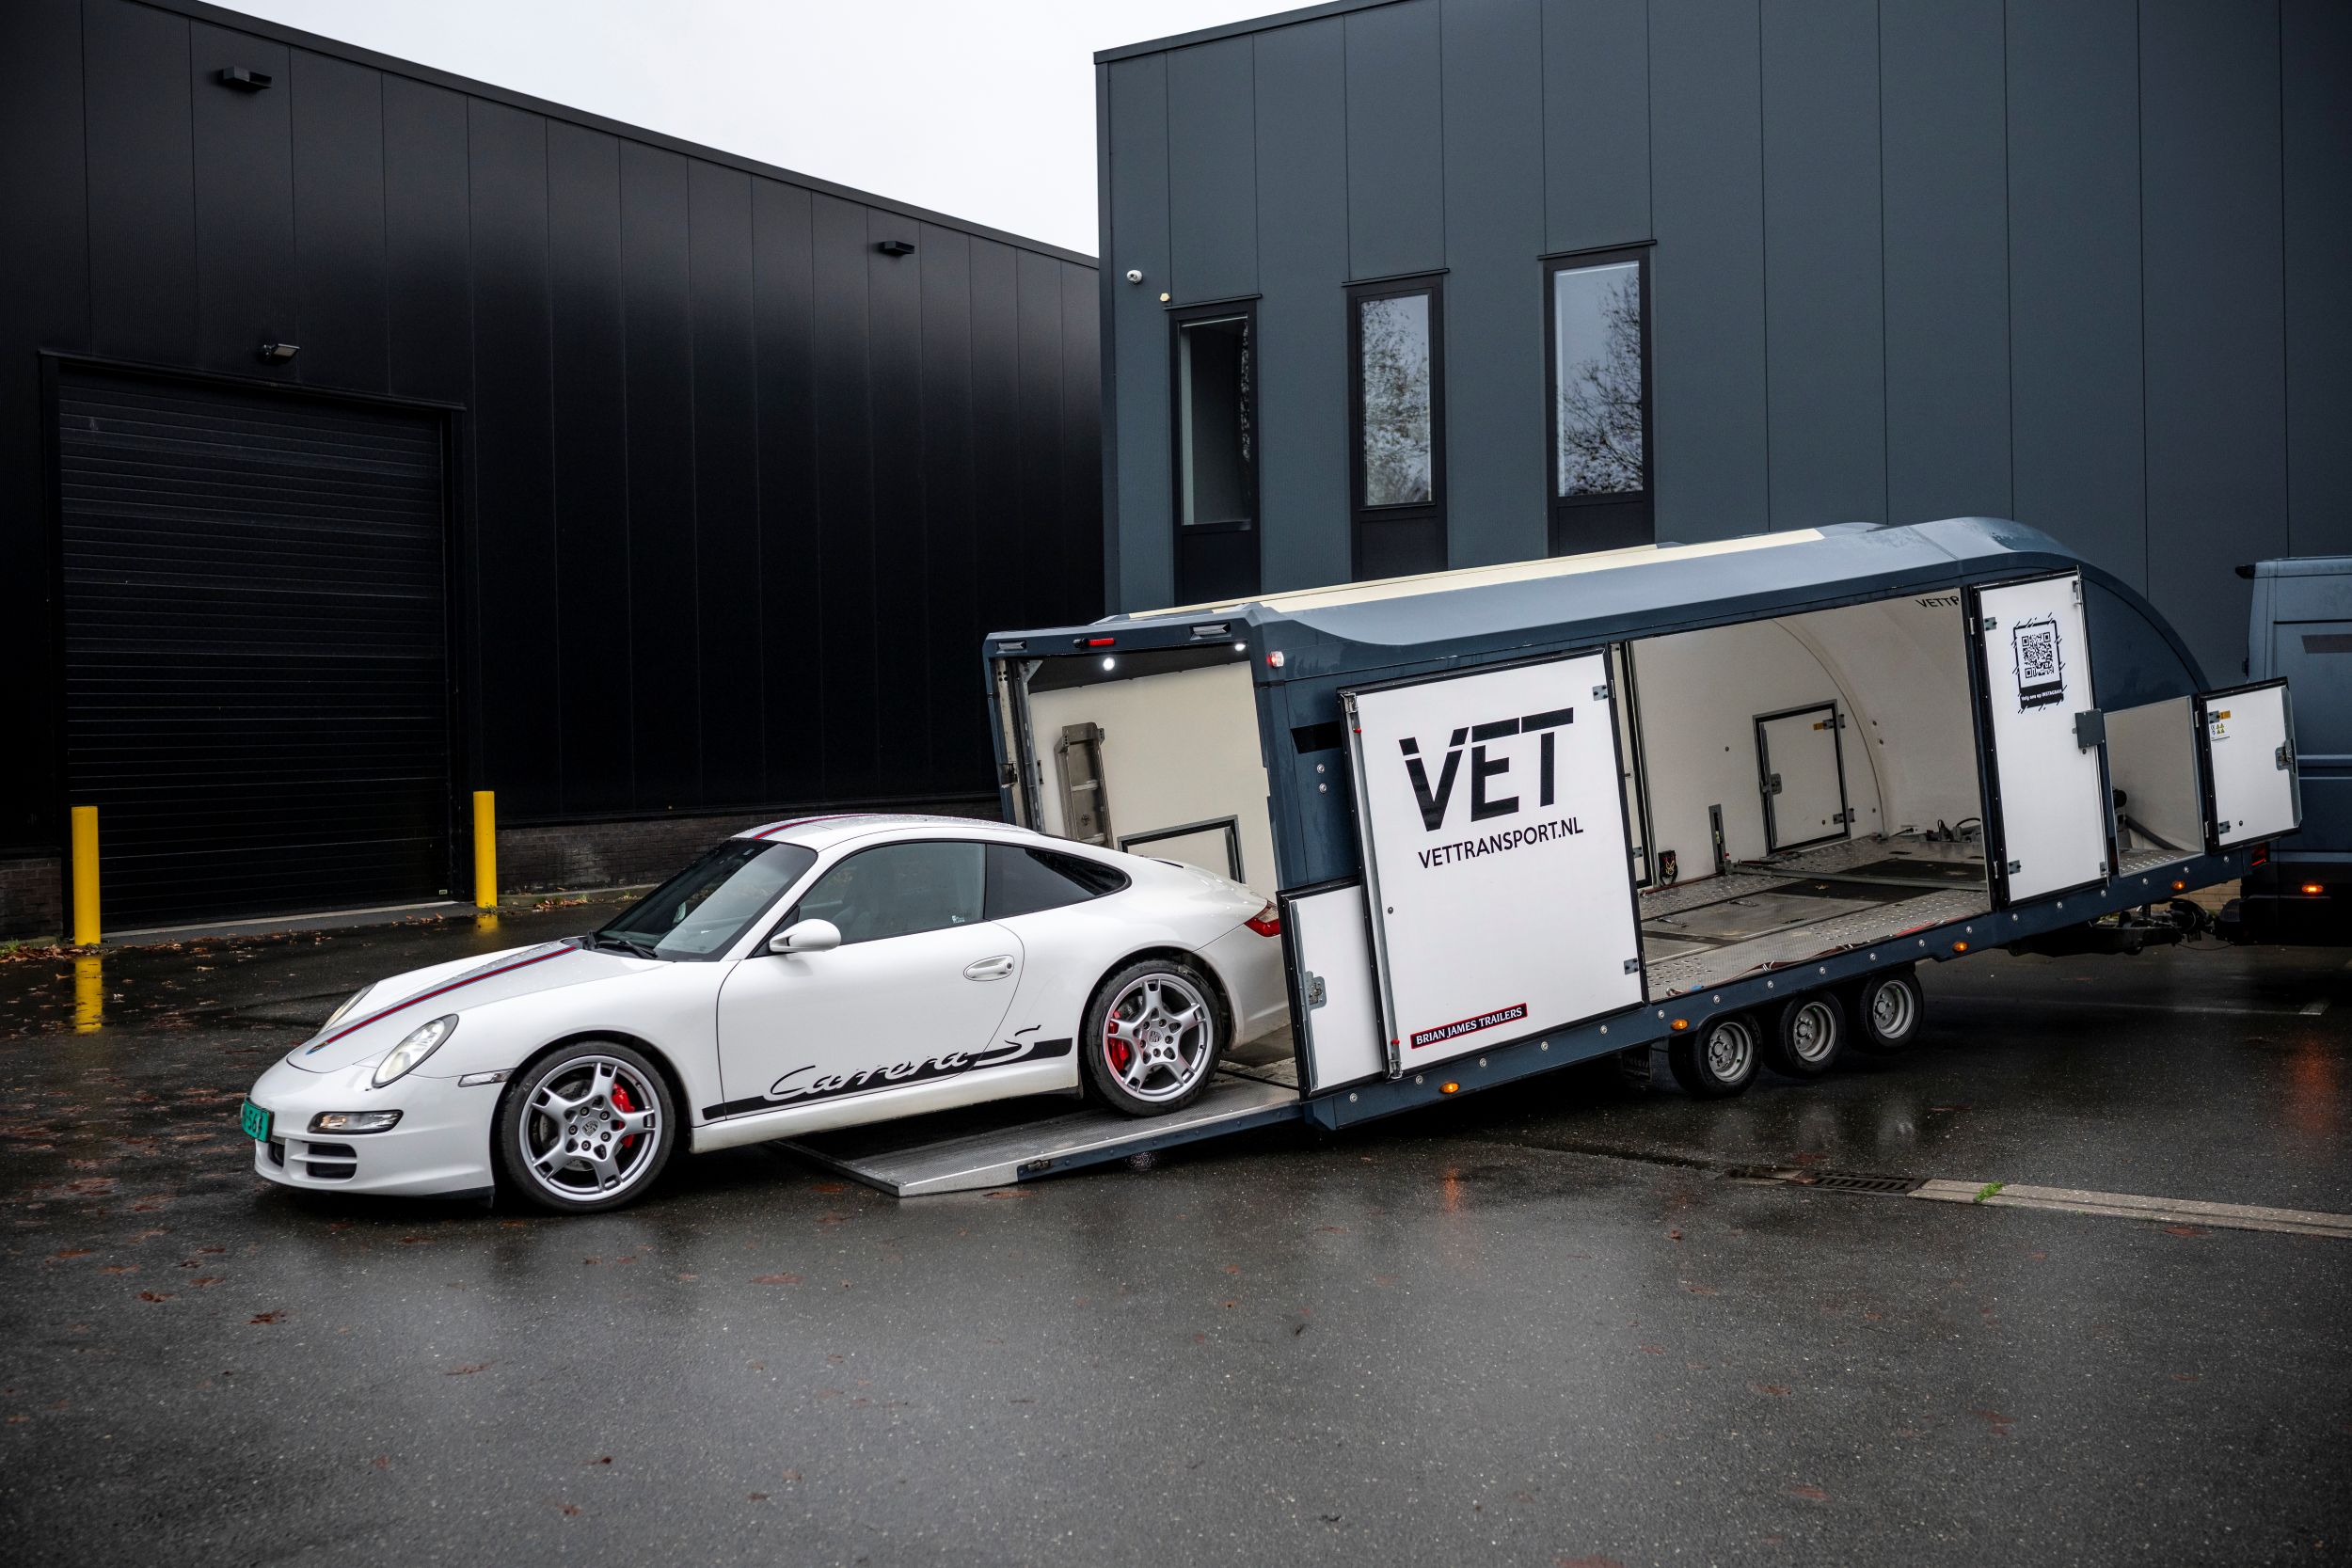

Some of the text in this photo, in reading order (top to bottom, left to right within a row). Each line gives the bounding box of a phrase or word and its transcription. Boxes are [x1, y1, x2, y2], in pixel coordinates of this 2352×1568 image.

[1399, 707, 1574, 832] VET
[1418, 816, 1583, 869] VETTRANSPORT.NL
[1415, 1006, 1523, 1045] BRIAN JAMES TRAILERS
[763, 1024, 1041, 1101] Carrera S
